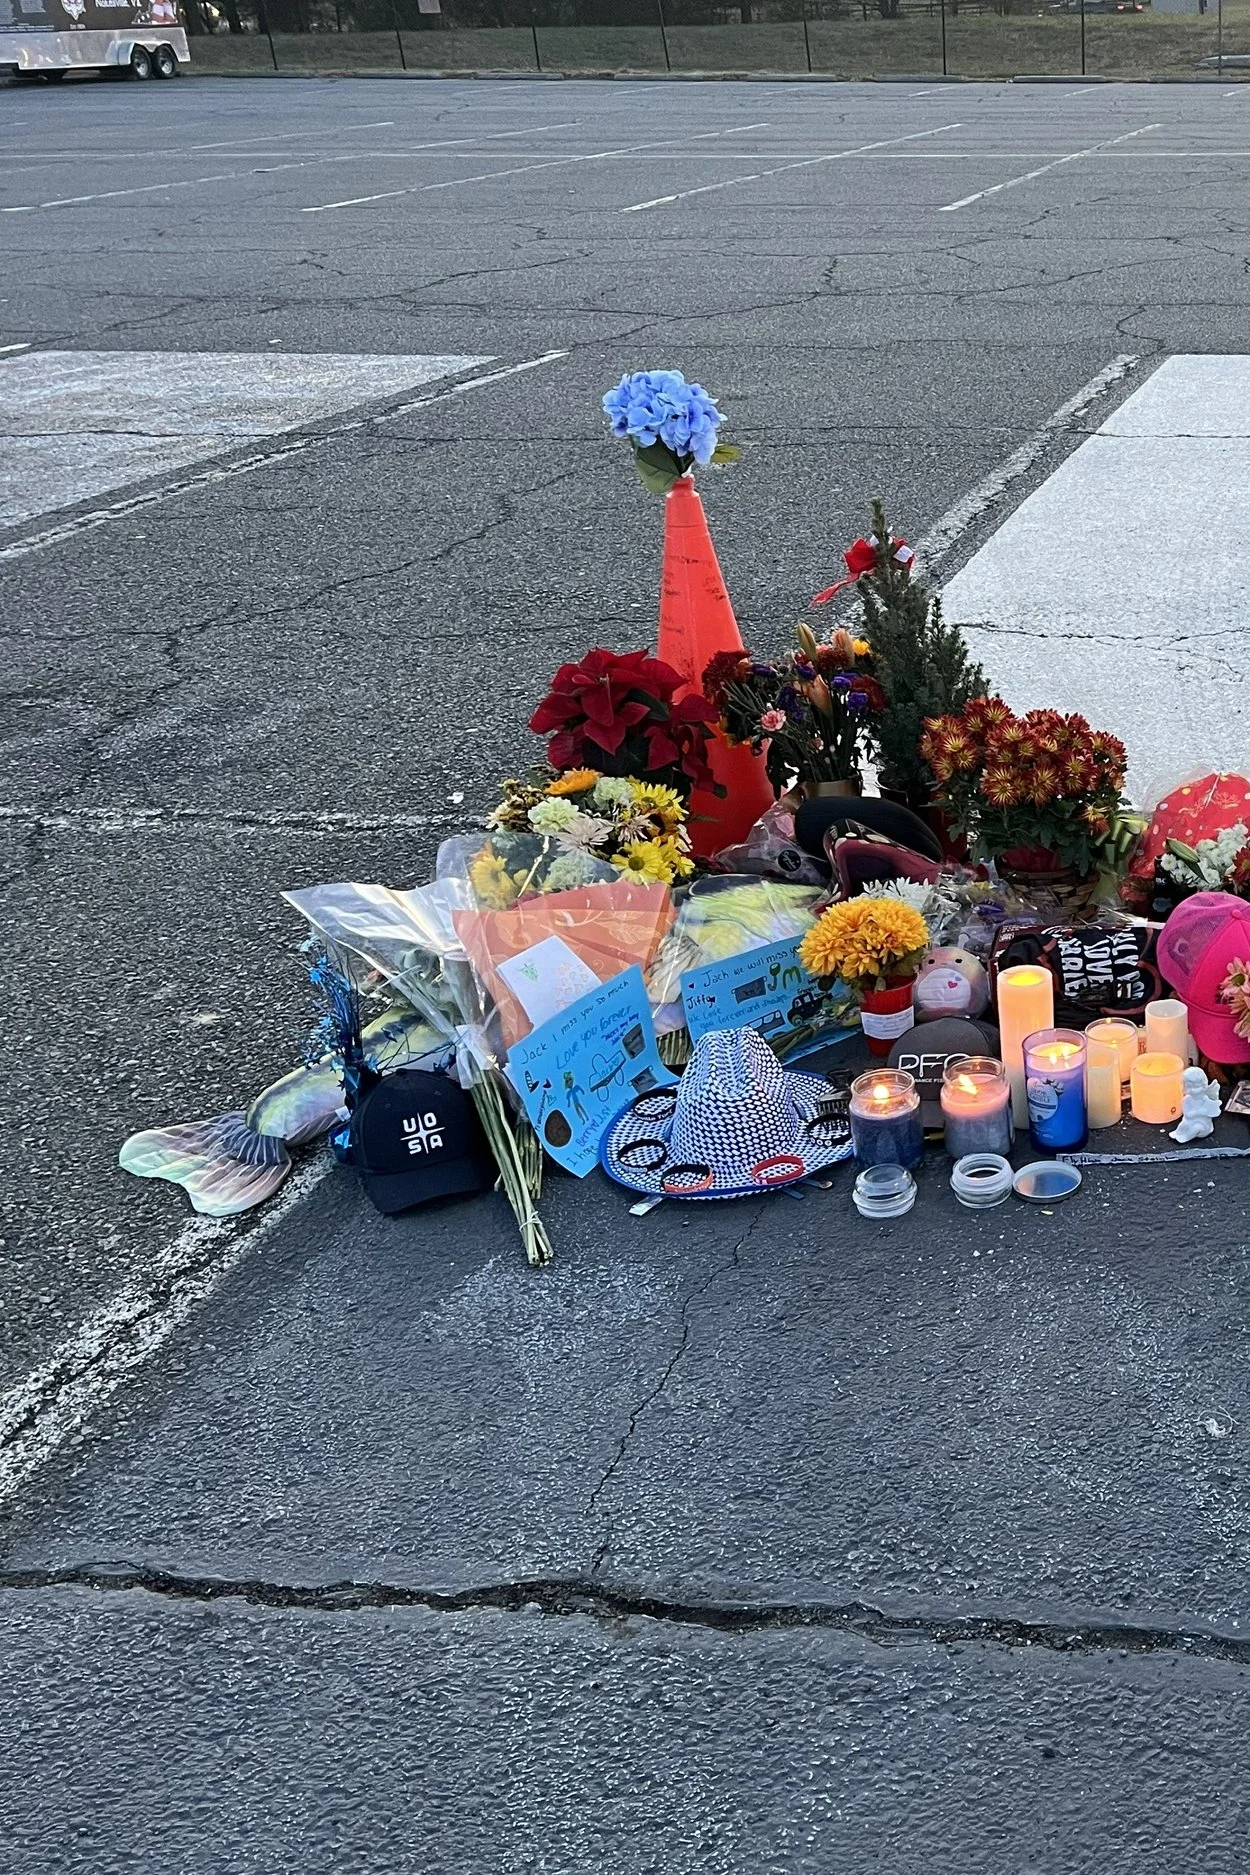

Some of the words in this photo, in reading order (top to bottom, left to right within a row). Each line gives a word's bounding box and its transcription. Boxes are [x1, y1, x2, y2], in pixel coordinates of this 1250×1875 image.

[701, 969, 729, 988] Jack
[766, 951, 788, 964] miss
[1083, 939, 1114, 989] LOVE
[521, 1042, 548, 1065] Jack
[561, 1017, 578, 1035] miss
[581, 1005, 594, 1020] you
[608, 980, 629, 998] much
[581, 1026, 597, 1048] you
